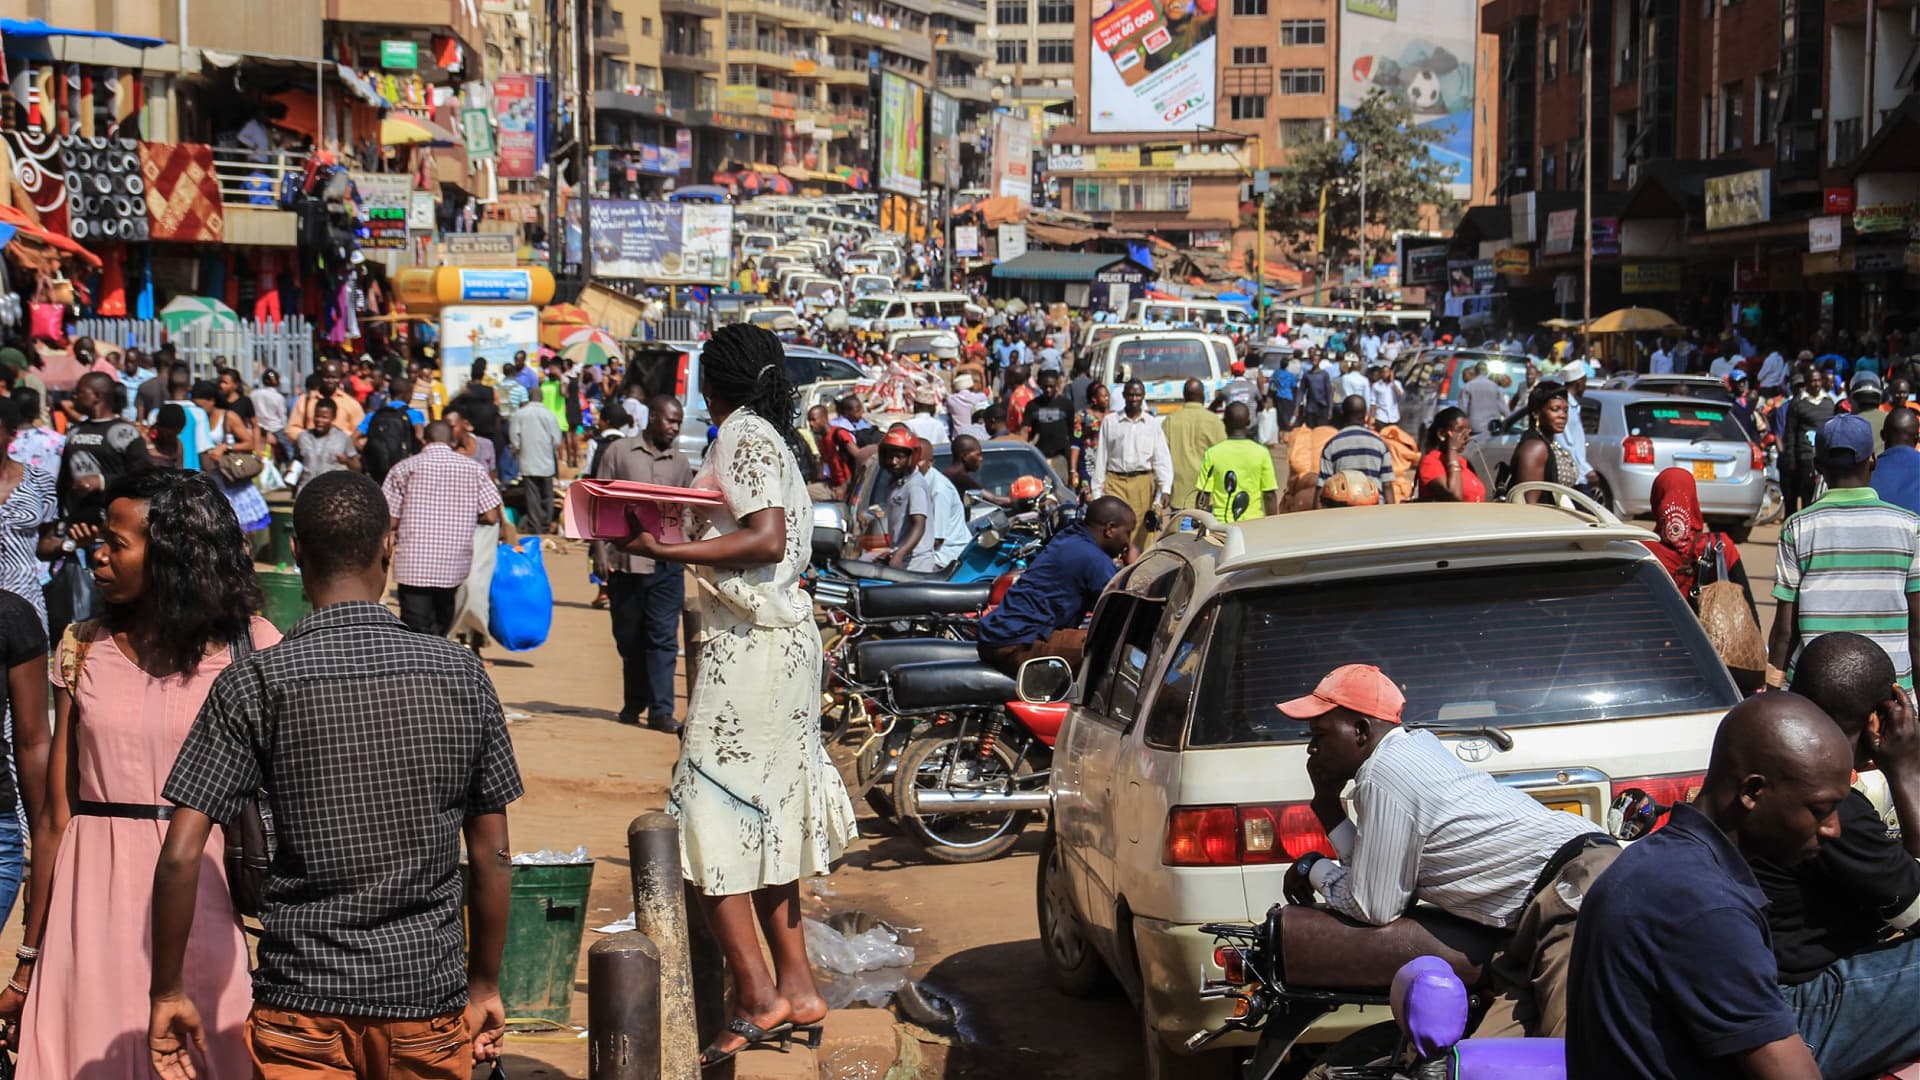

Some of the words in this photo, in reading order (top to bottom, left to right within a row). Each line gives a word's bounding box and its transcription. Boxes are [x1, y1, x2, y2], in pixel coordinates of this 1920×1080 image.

[1121, 22, 1135, 37] 60
[1134, 9, 1155, 28] 000
[450, 242, 511, 253] CLINIC
[1098, 272, 1122, 282] POLICE
[1125, 273, 1142, 283] POST
